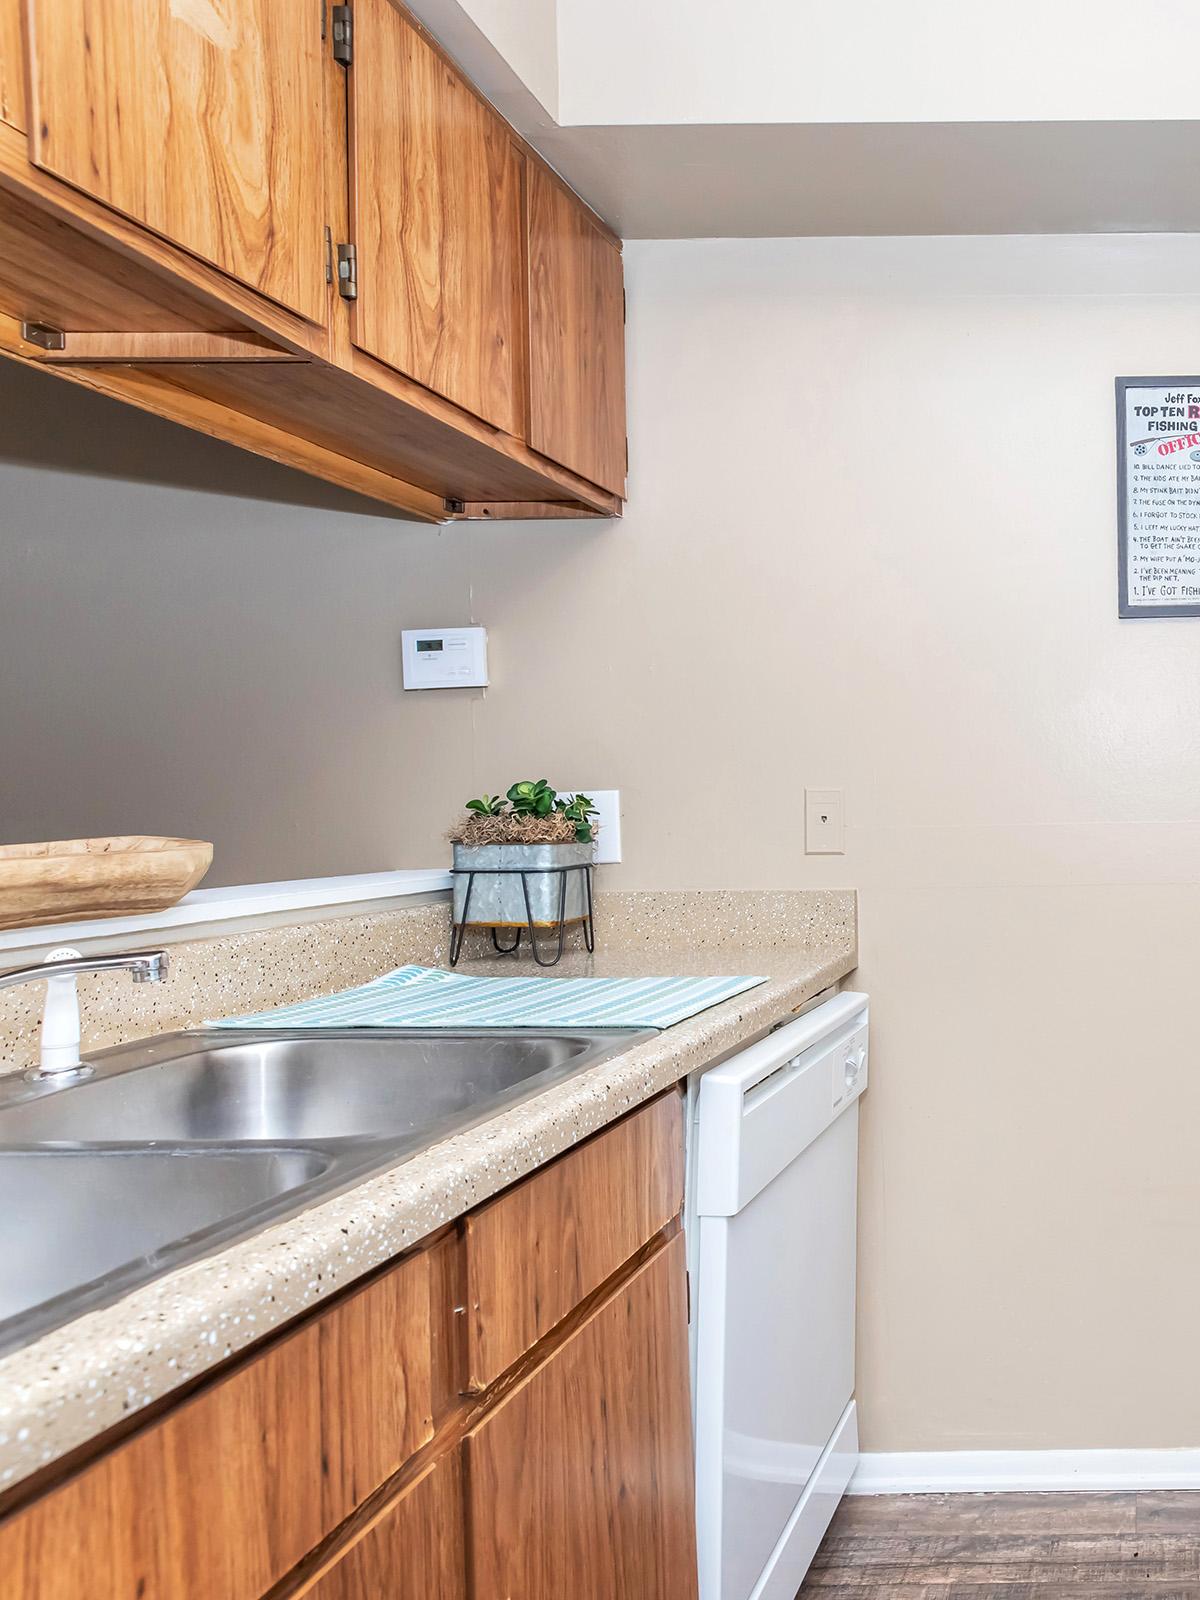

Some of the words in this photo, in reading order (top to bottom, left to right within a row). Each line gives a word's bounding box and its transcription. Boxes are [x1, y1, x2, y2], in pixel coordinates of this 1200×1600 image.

[1164, 392, 1185, 404] Jeff
[1134, 406, 1158, 417] TOP
[1160, 406, 1184, 417] TEN
[1147, 421, 1198, 432] FISHING
[1156, 463, 1177, 471] DANCE
[1168, 486, 1183, 495] BAIT
[1139, 498, 1151, 506] THE
[1144, 511, 1167, 519] FORGOT
[1170, 511, 1178, 519] TO
[1144, 523, 1158, 531] LEFT
[1169, 524, 1187, 532] LUCKY
[1188, 524, 1200, 532] HAT
[1152, 535, 1169, 543] BOAT
[1170, 535, 1185, 543] AIN'T
[1150, 542, 1162, 550] GET
[1163, 542, 1175, 550] THE
[1139, 555, 1149, 563] MY
[1150, 555, 1165, 563] WIFE
[1165, 555, 1177, 563] PUT
[1153, 567, 1169, 575] BEEN
[1169, 568, 1196, 576] MEANING
[1142, 585, 1156, 597] I'VE
[1160, 585, 1177, 596] GOT
